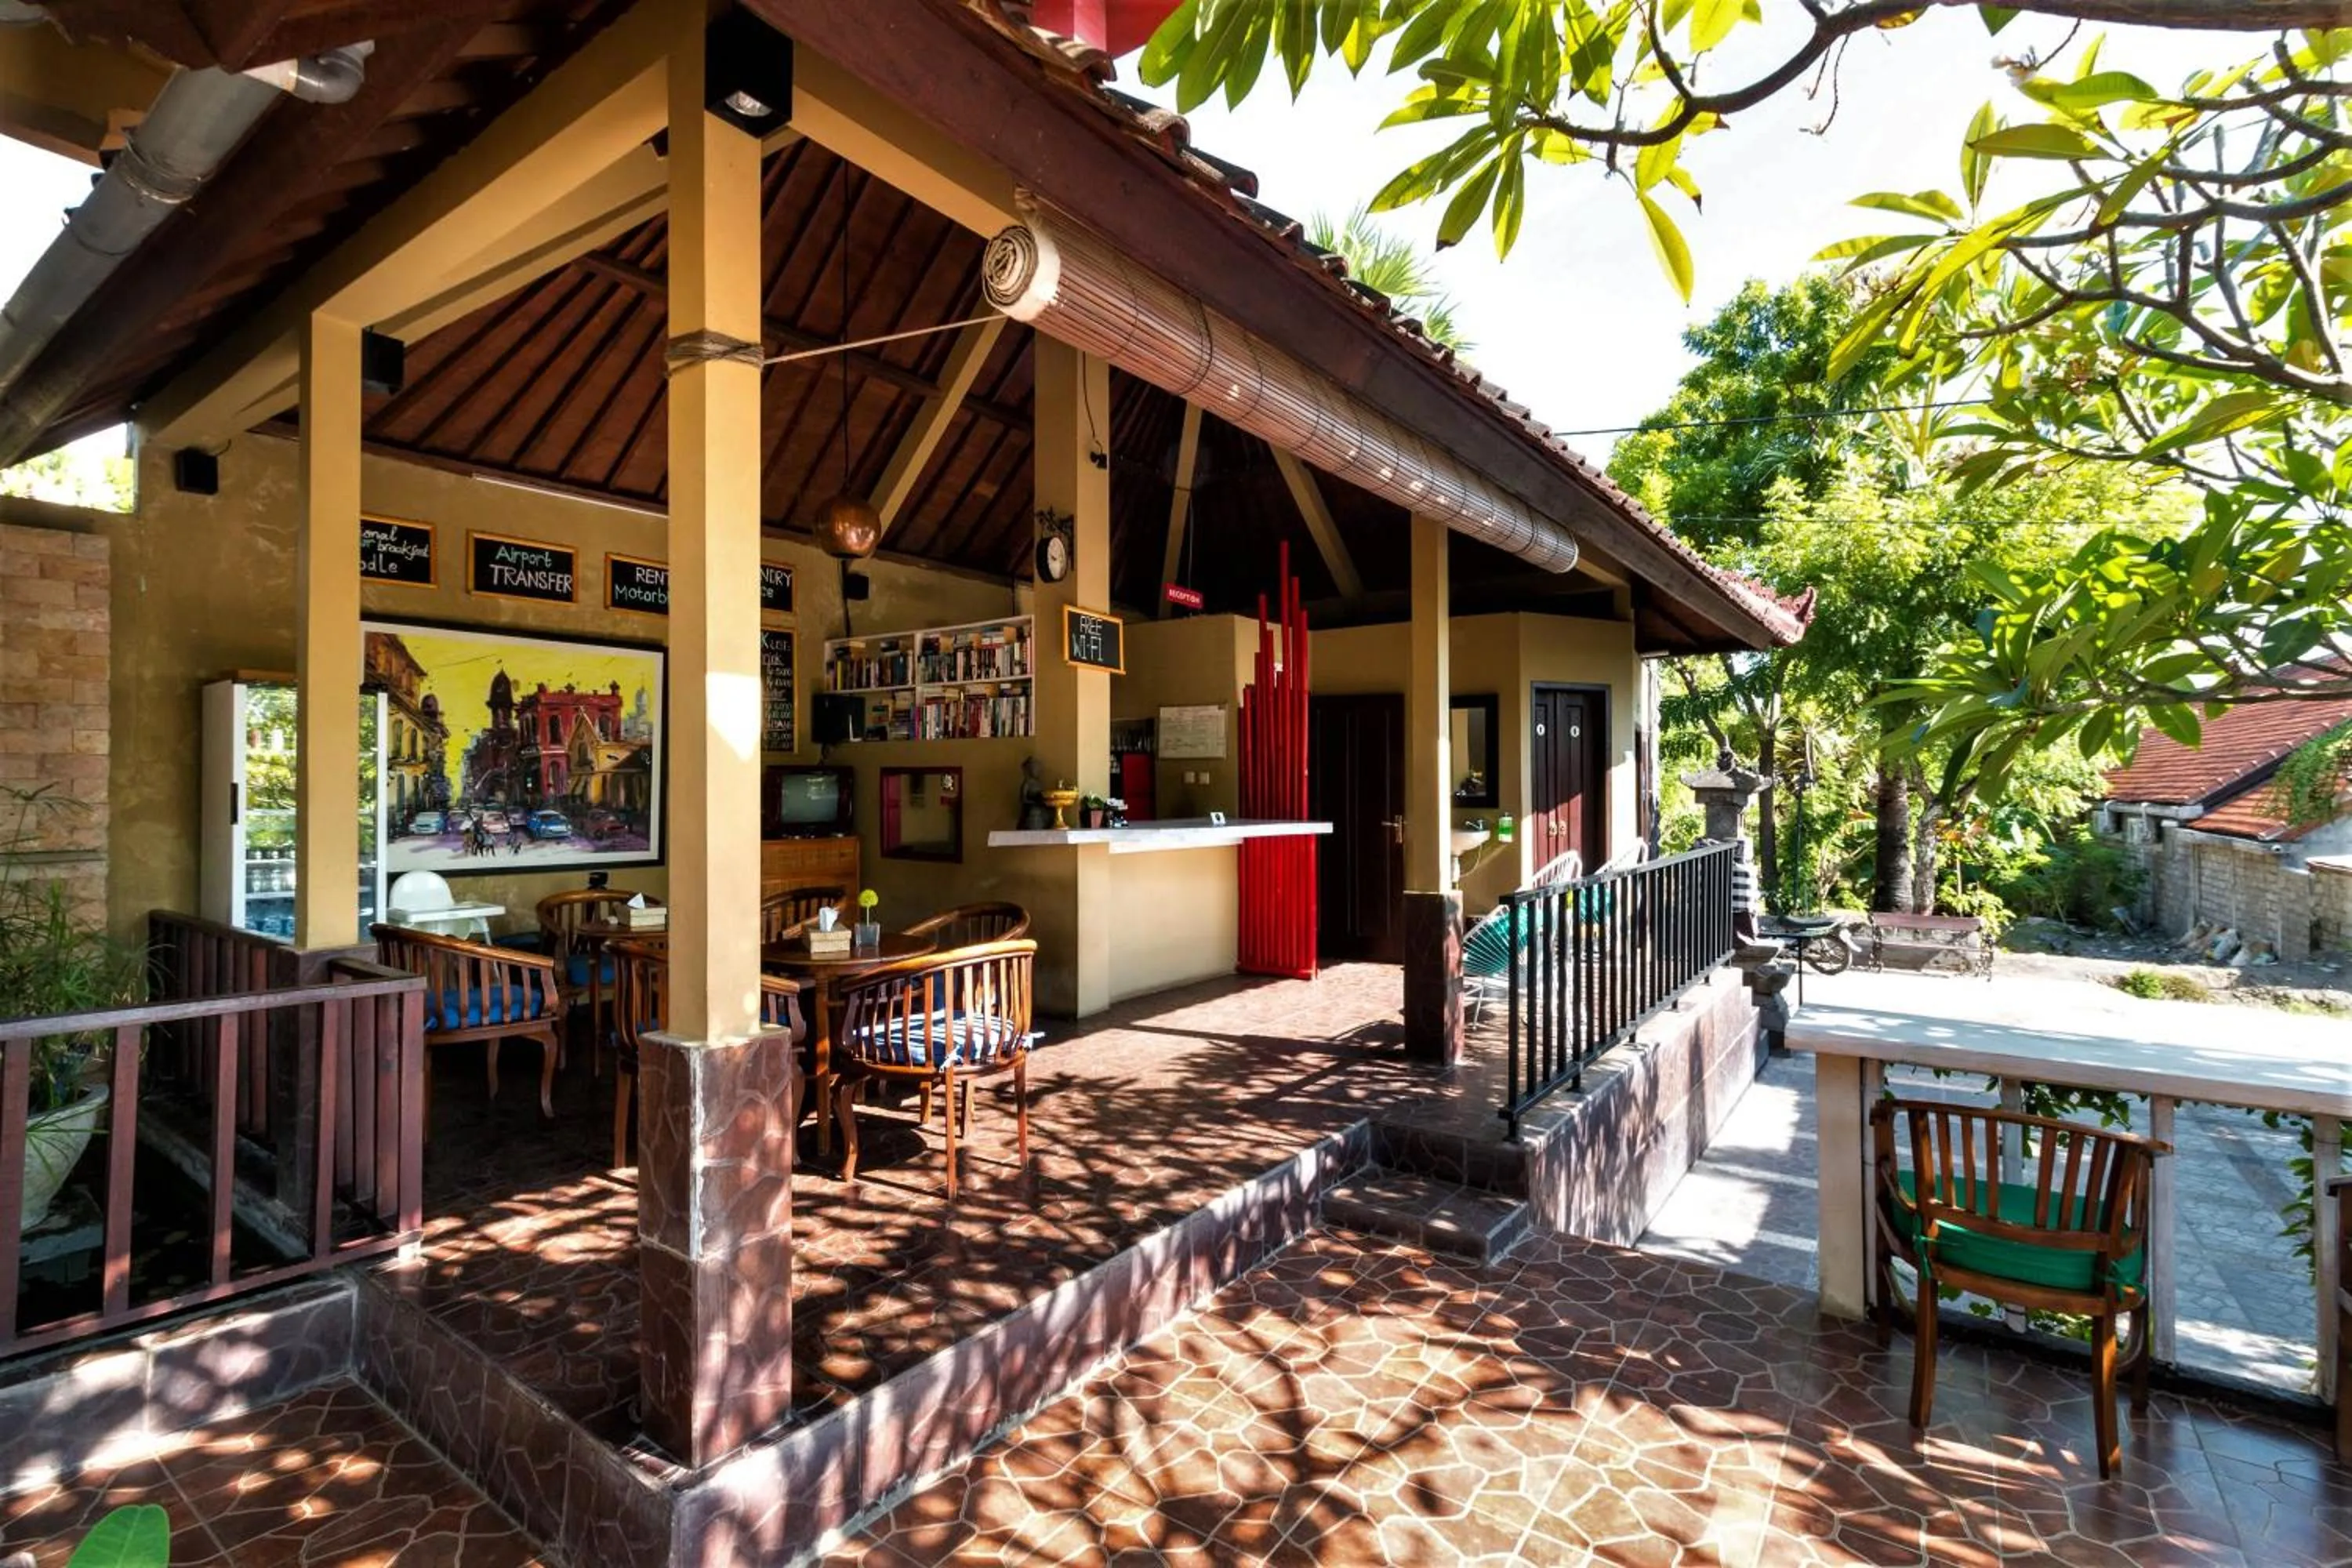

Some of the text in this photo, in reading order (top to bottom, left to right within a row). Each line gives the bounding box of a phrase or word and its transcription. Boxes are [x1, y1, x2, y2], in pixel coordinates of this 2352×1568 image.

[362, 525, 397, 542] onal
[360, 553, 398, 573] odle
[495, 545, 552, 569] Airport
[489, 564, 572, 593] TRANSFER
[760, 567, 791, 587] NDRY
[614, 583, 668, 604] Motorb
[1080, 615, 1103, 636] FREE
